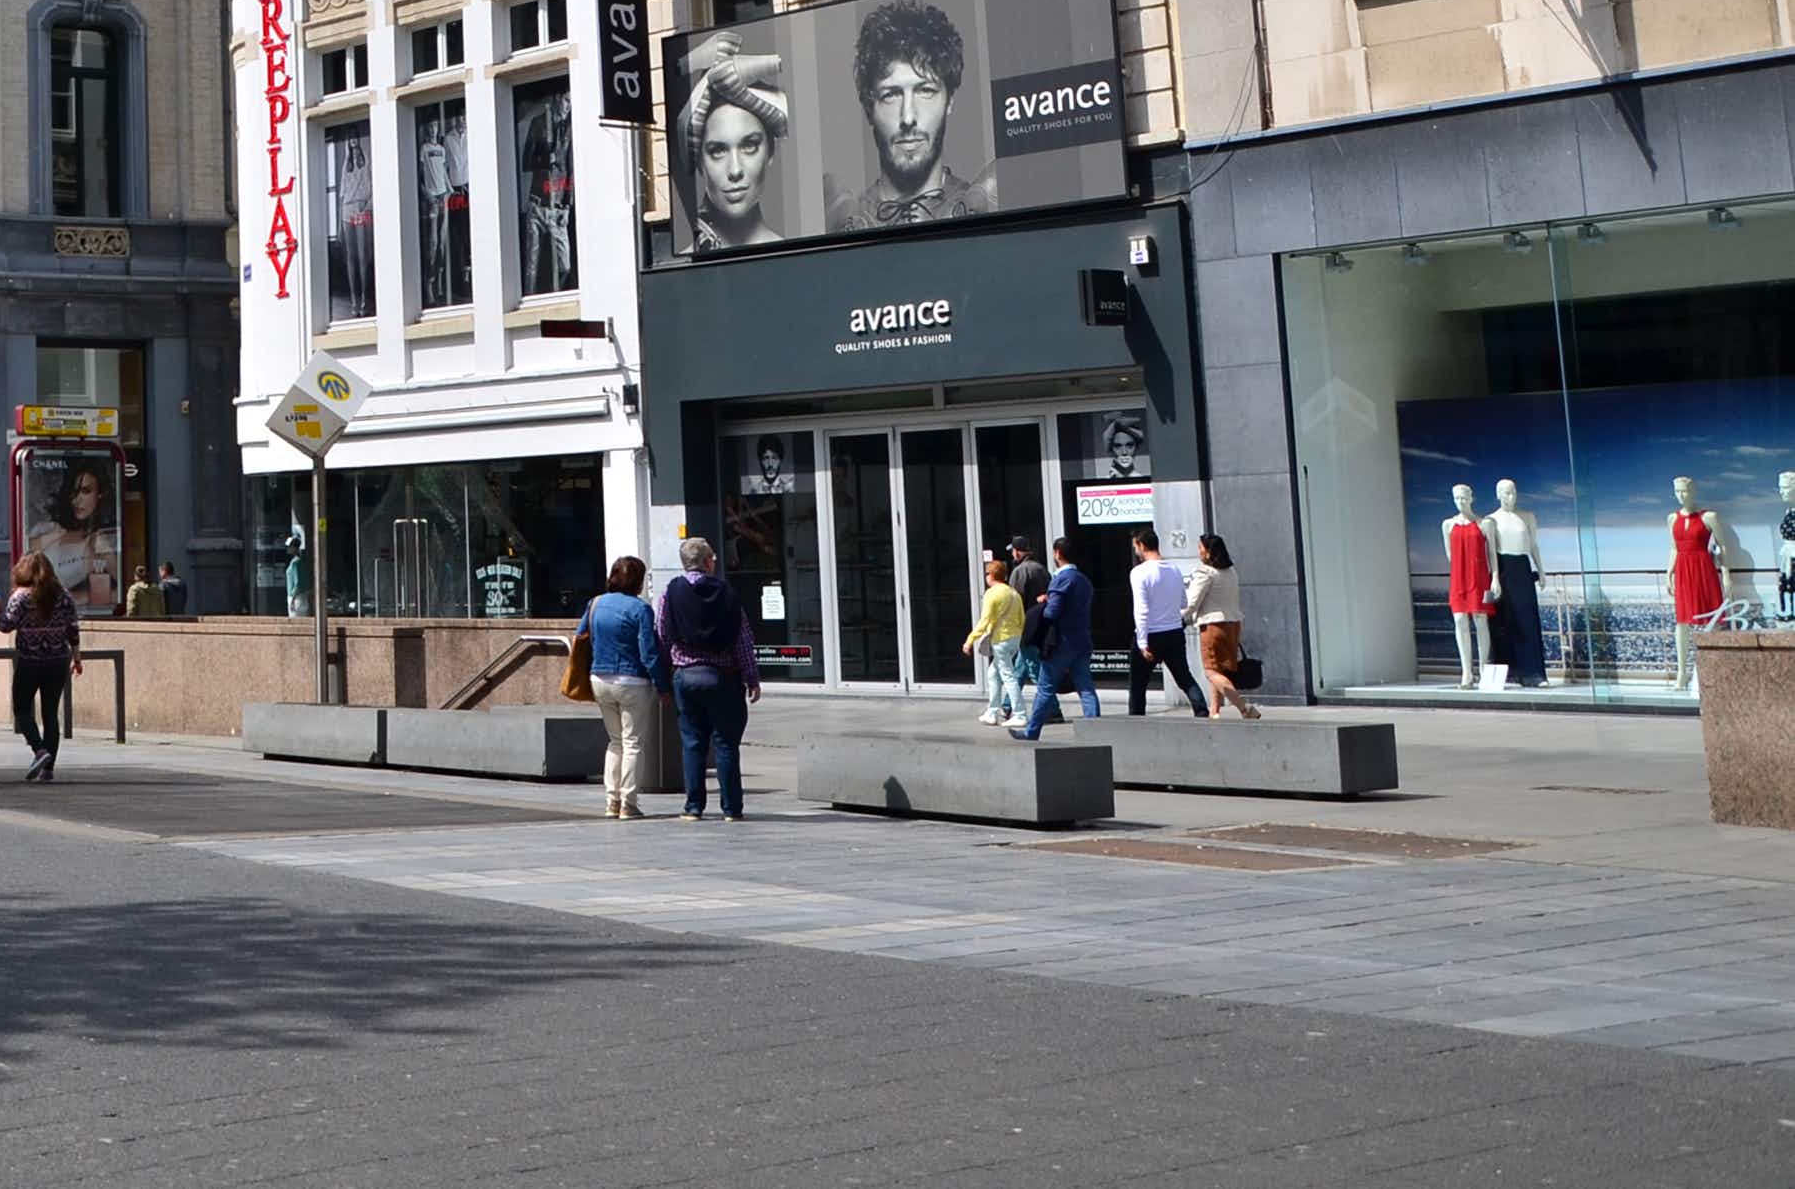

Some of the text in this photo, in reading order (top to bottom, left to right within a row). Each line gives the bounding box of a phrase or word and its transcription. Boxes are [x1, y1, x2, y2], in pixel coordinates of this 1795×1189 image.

[1005, 81, 1110, 121] avance
[1007, 112, 1113, 137] QUALITY SHOES FOR YOU
[850, 299, 950, 333] avance
[835, 334, 952, 354] QUALITY SHOES & FASHION
[32, 460, 69, 469] CHANEL
[1081, 498, 1119, 517] 20%
